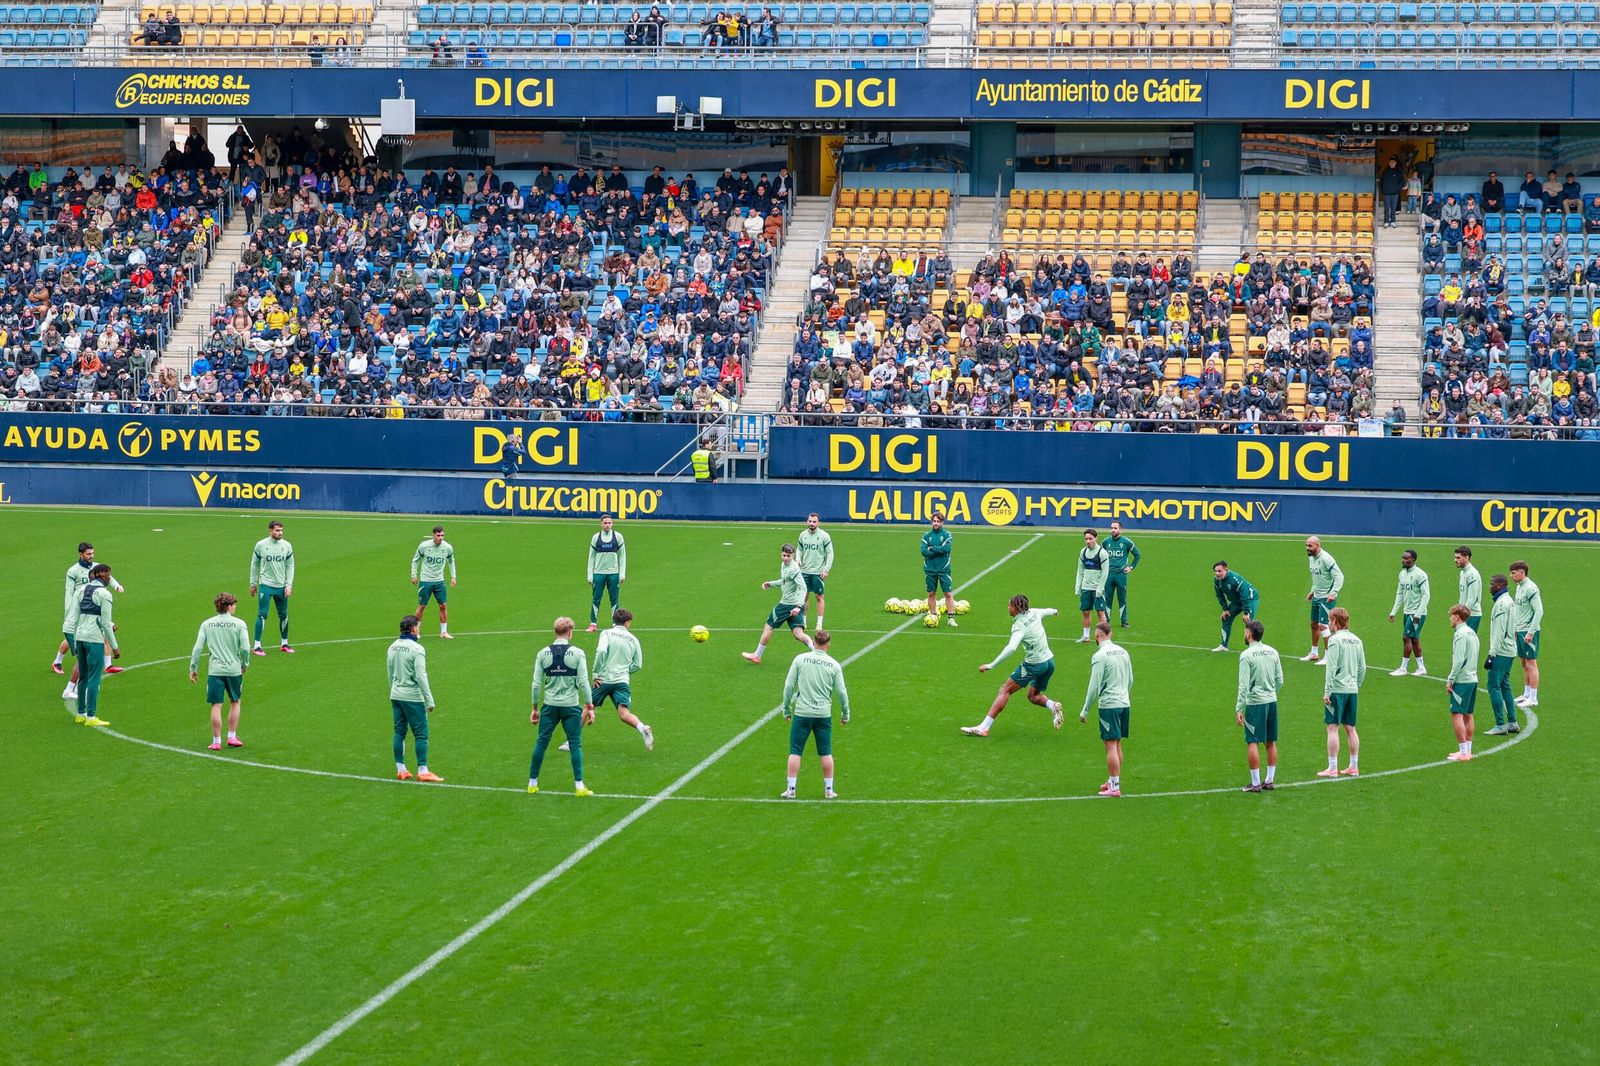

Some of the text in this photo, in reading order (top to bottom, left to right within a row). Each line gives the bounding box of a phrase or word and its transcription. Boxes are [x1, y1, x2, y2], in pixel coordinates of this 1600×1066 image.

[147, 74, 251, 89] CHICHOS S.L.
[474, 77, 554, 107] DIGI
[814, 78, 897, 108] DIGI
[975, 78, 1203, 106] Ayuntamiento de Cádiz
[1285, 79, 1371, 110] DIGI
[3, 425, 109, 450] AYUDA
[160, 428, 261, 452] PYMES
[829, 433, 938, 474] DIGI
[1236, 440, 1350, 482] DIGI
[219, 482, 301, 501] macron
[988, 496, 1011, 509] EA
[848, 489, 972, 522] LALIGA
[986, 508, 1013, 516] SPORTS
[1025, 495, 1254, 522] HYPERMOTION
[1480, 499, 1600, 534] Cruzca
[266, 554, 285, 563] DIGI
[426, 555, 444, 565] DIGI
[803, 656, 833, 668] macron
